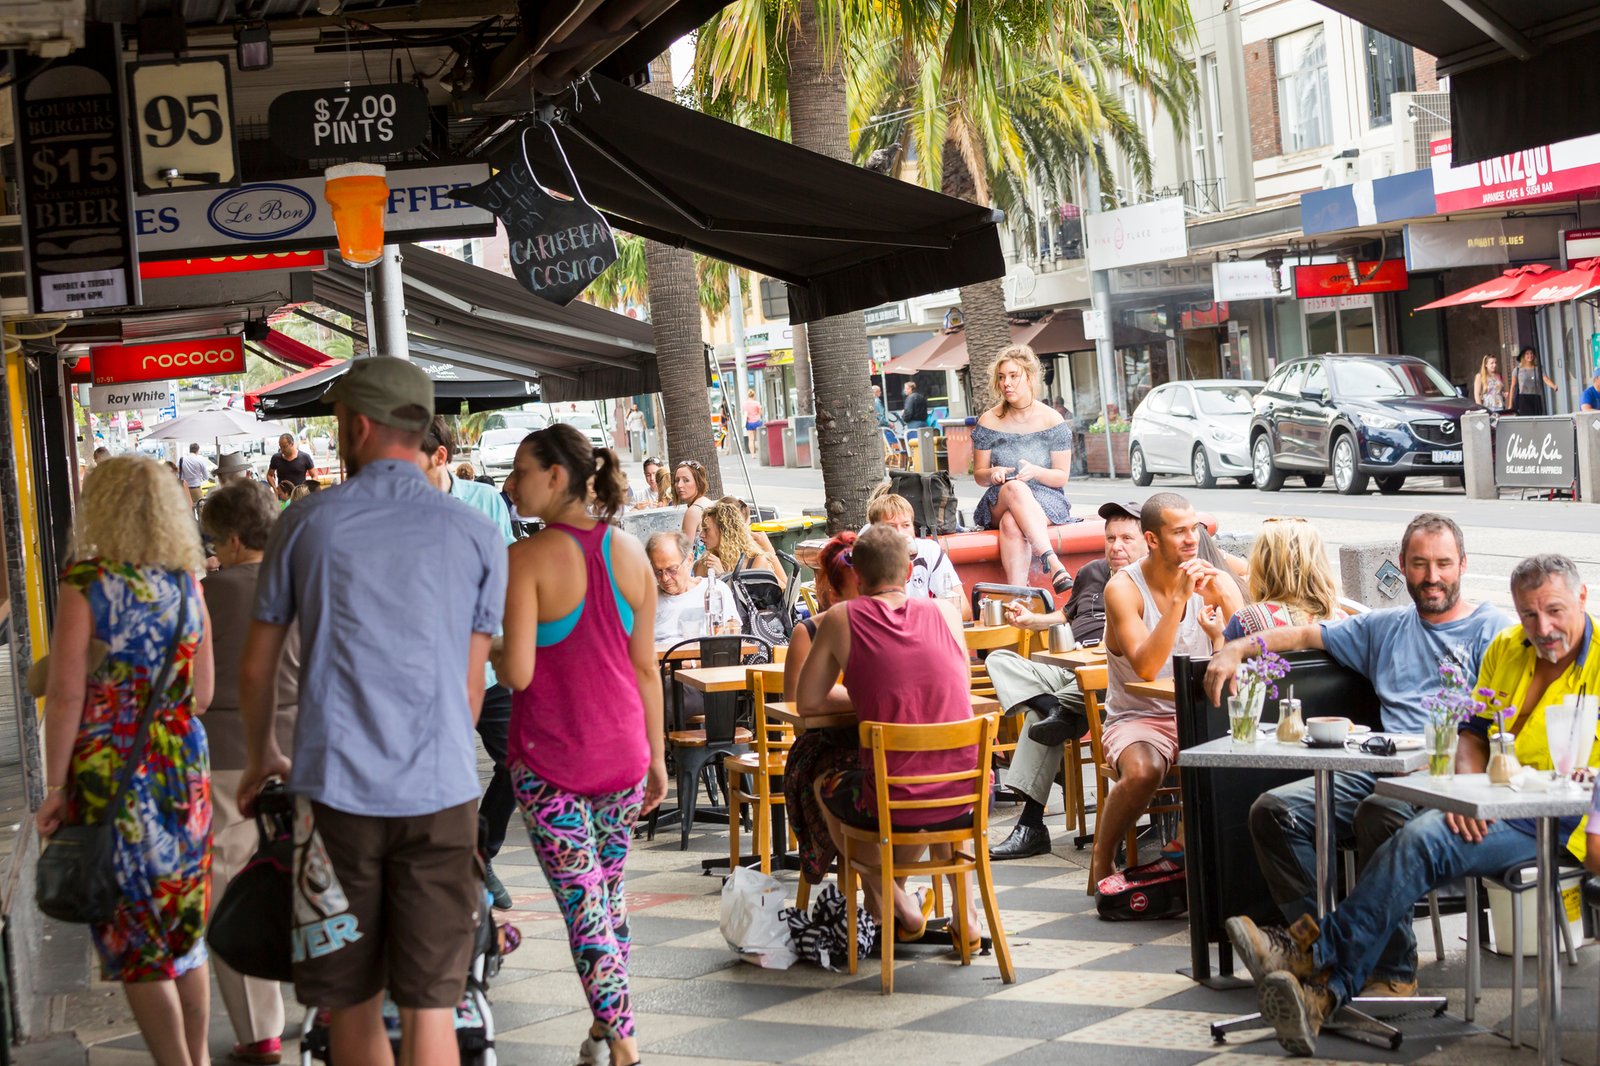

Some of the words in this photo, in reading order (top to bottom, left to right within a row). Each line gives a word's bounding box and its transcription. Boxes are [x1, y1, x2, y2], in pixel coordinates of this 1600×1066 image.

[26, 99, 112, 119] GOURMET
[144, 94, 223, 148] 95
[314, 94, 397, 121] $7.00
[28, 115, 115, 136] BURGERS
[313, 118, 394, 146] PINTS
[32, 145, 118, 190] $15
[484, 162, 528, 209] JUG
[1505, 188, 1519, 200] CAFE
[1541, 182, 1554, 193] BAR
[36, 198, 121, 230] BEER
[135, 207, 180, 235] ES
[225, 202, 252, 223] Le
[258, 199, 305, 221] Bon
[511, 222, 613, 265] CARIBBEAN
[1467, 237, 1495, 248] RABBIT
[1498, 235, 1525, 247] BLUES
[530, 256, 606, 291] COSMO
[142, 349, 235, 370] rococo
[107, 394, 131, 406] Ray
[132, 391, 166, 403] White
